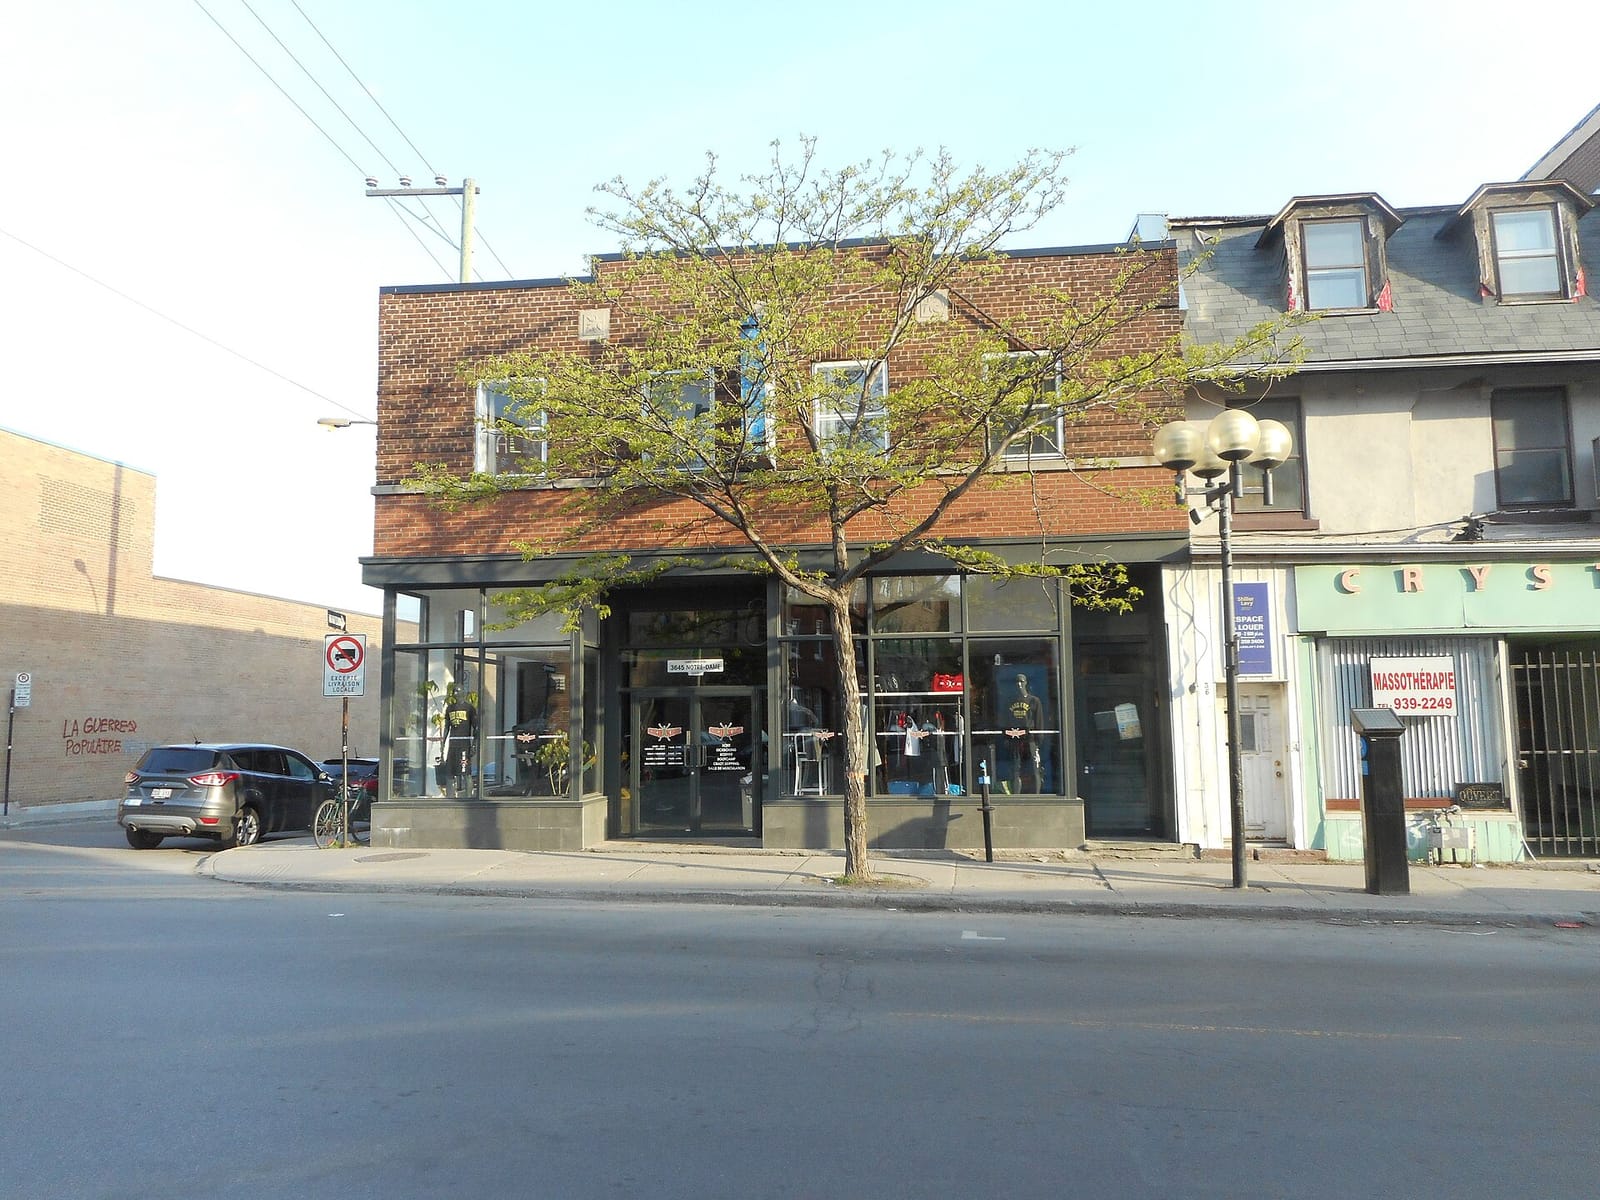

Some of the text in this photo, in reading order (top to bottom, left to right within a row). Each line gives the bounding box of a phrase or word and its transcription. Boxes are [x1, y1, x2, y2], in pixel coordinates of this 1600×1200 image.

[1341, 564, 1600, 593] CRYS
[1373, 668, 1455, 691] MASSOTHÉRAPIE
[1394, 697, 1453, 710] 939-2249
[63, 719, 79, 738] LA
[66, 738, 121, 756] POPULAIRE
